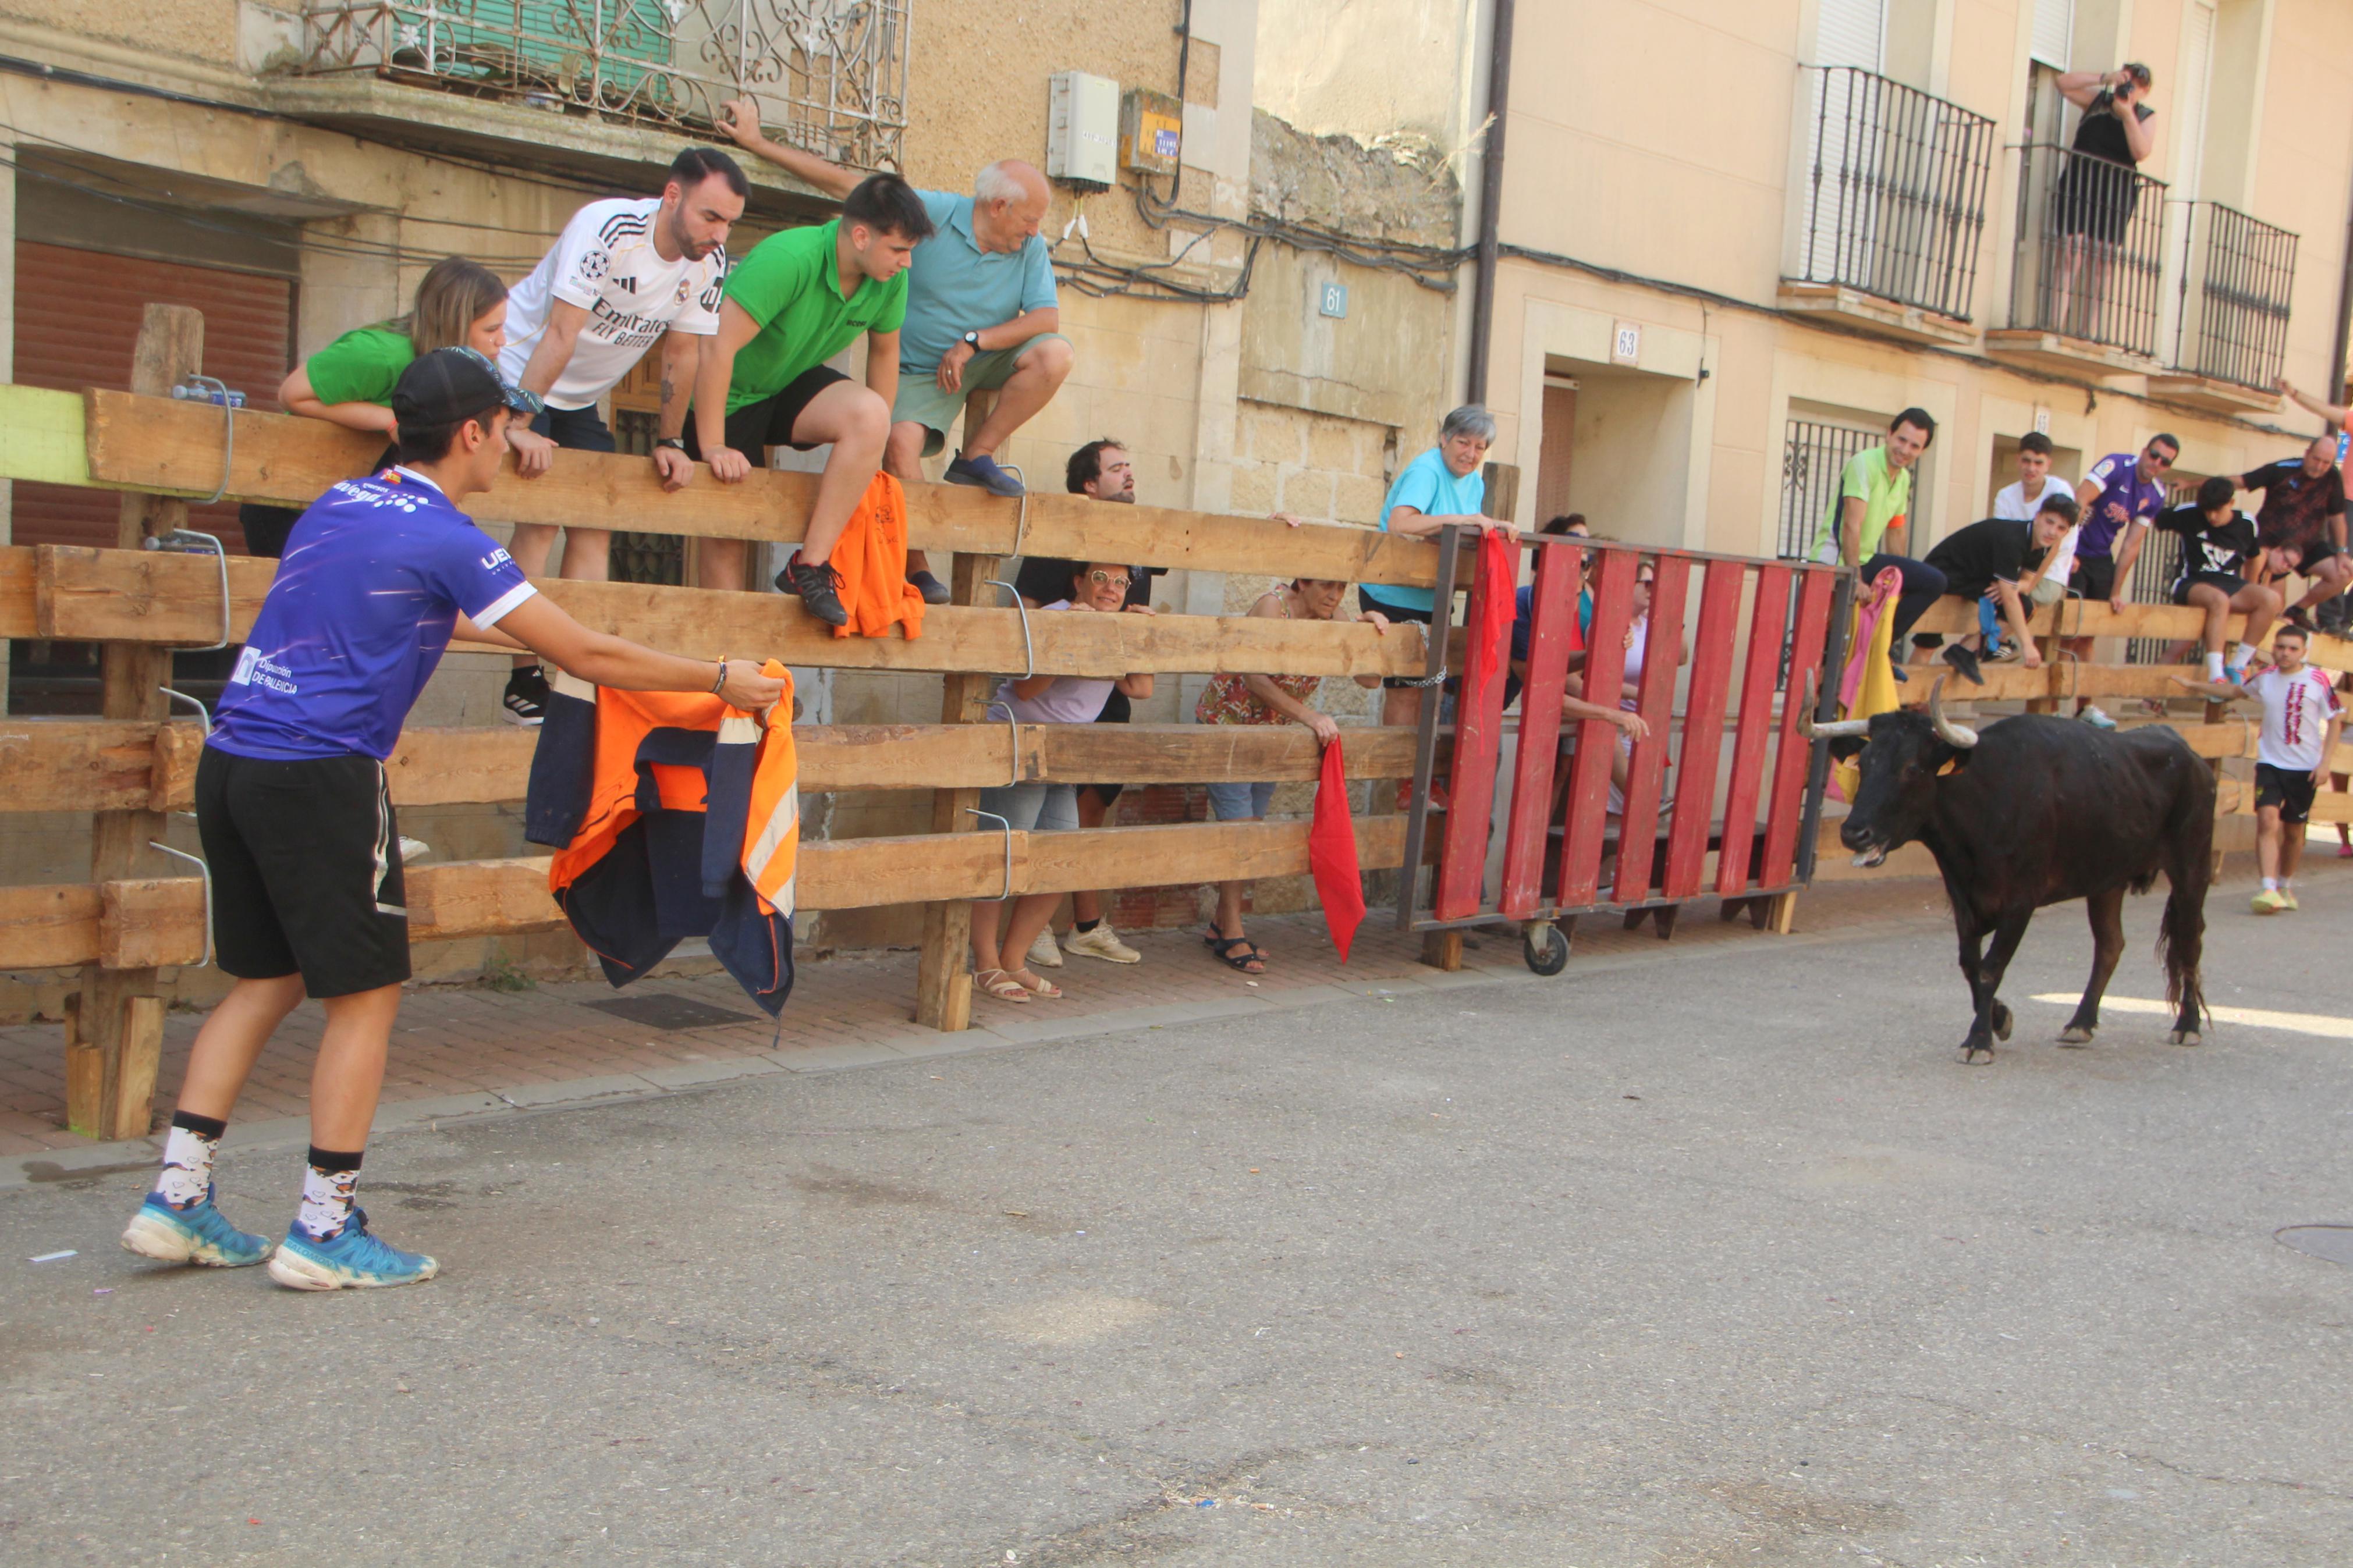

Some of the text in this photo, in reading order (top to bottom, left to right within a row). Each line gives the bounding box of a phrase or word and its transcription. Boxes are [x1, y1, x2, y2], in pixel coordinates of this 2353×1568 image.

[1327, 287, 1340, 312] 61
[592, 322, 617, 340] FLY
[1619, 331, 1635, 355] 63
[251, 670, 298, 695] DE PALENCIA
[286, 1240, 333, 1267] SALOMON
